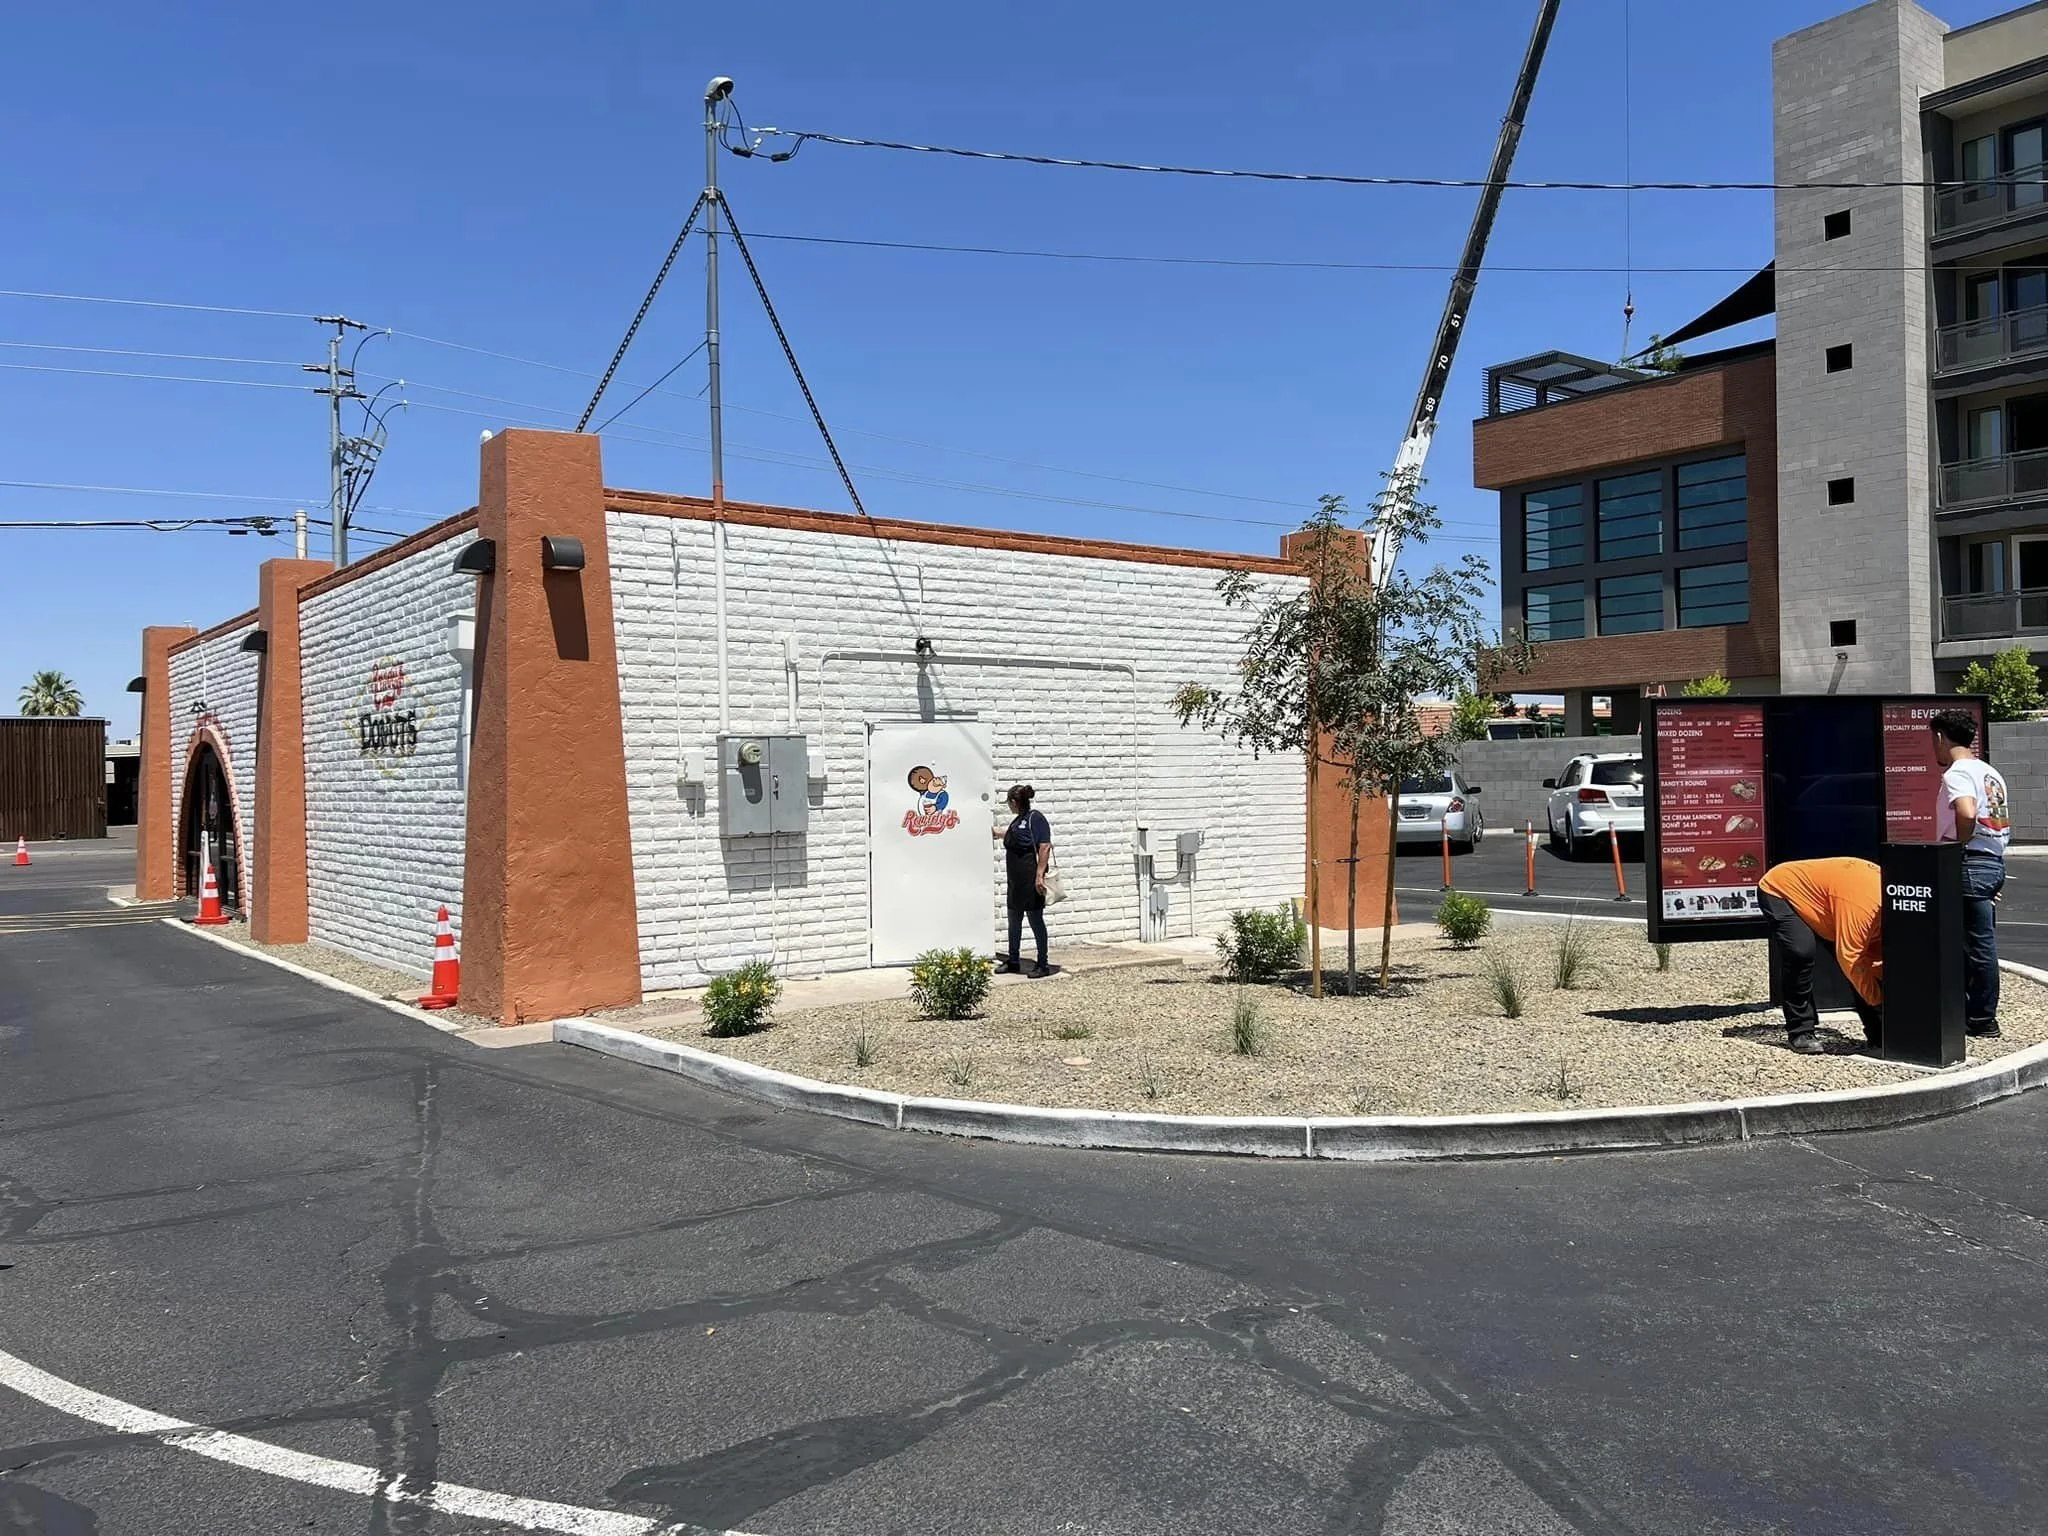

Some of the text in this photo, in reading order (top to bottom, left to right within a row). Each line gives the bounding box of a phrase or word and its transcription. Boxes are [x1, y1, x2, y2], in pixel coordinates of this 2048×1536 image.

[1451, 313, 1462, 328] 51
[1437, 355, 1449, 370] 70
[1425, 397, 1436, 412] 89
[1657, 708, 1682, 716] DOZENS
[901, 809, 960, 837] Randy's
[1886, 884, 1932, 898] ORDER
[1892, 899, 1927, 912] HERE
